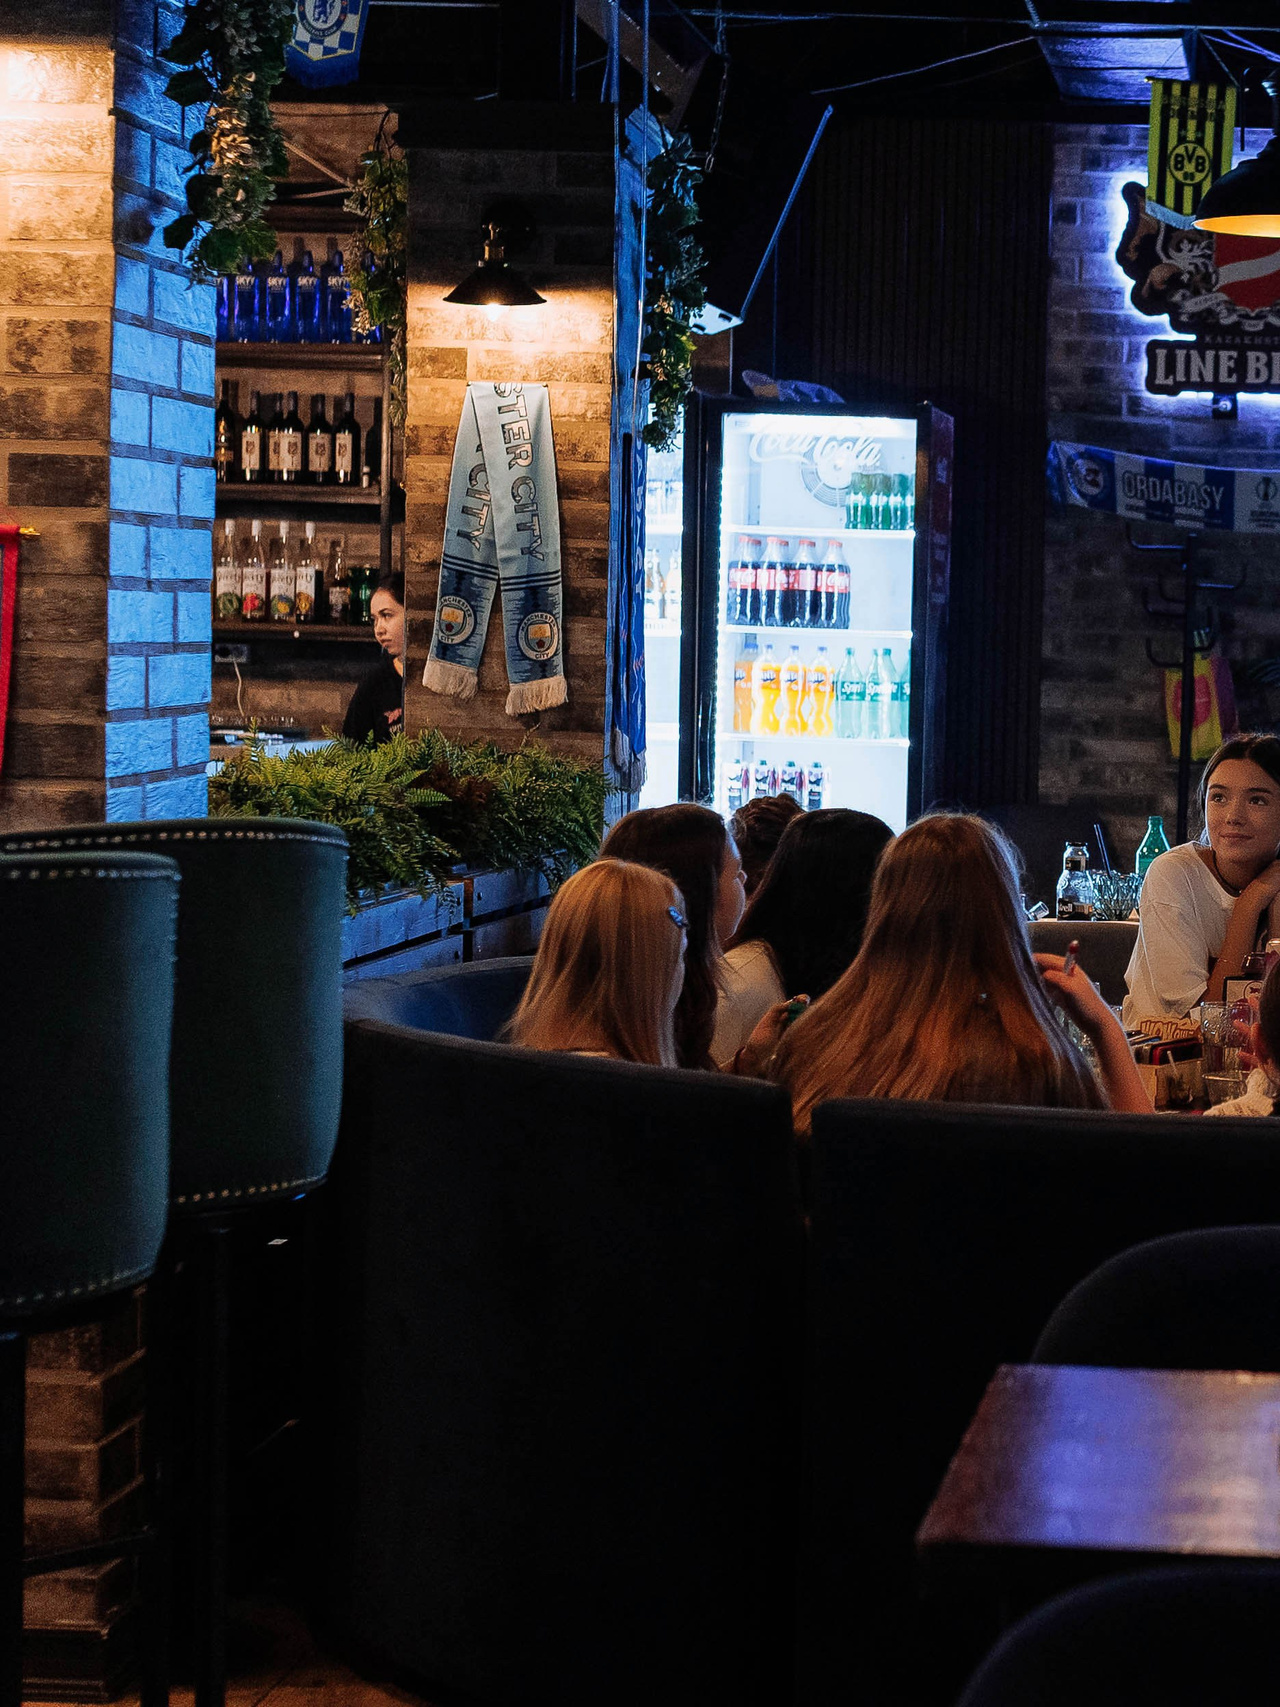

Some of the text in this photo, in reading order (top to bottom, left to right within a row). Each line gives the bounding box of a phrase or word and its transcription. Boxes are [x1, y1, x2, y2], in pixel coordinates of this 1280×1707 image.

[1174, 145, 1205, 172] BVB
[1154, 348, 1239, 386] LINE
[456, 463, 492, 551] CITY
[1122, 470, 1225, 510] ORDABASY
[510, 475, 545, 562] CITY
[534, 652, 550, 660] CITY
